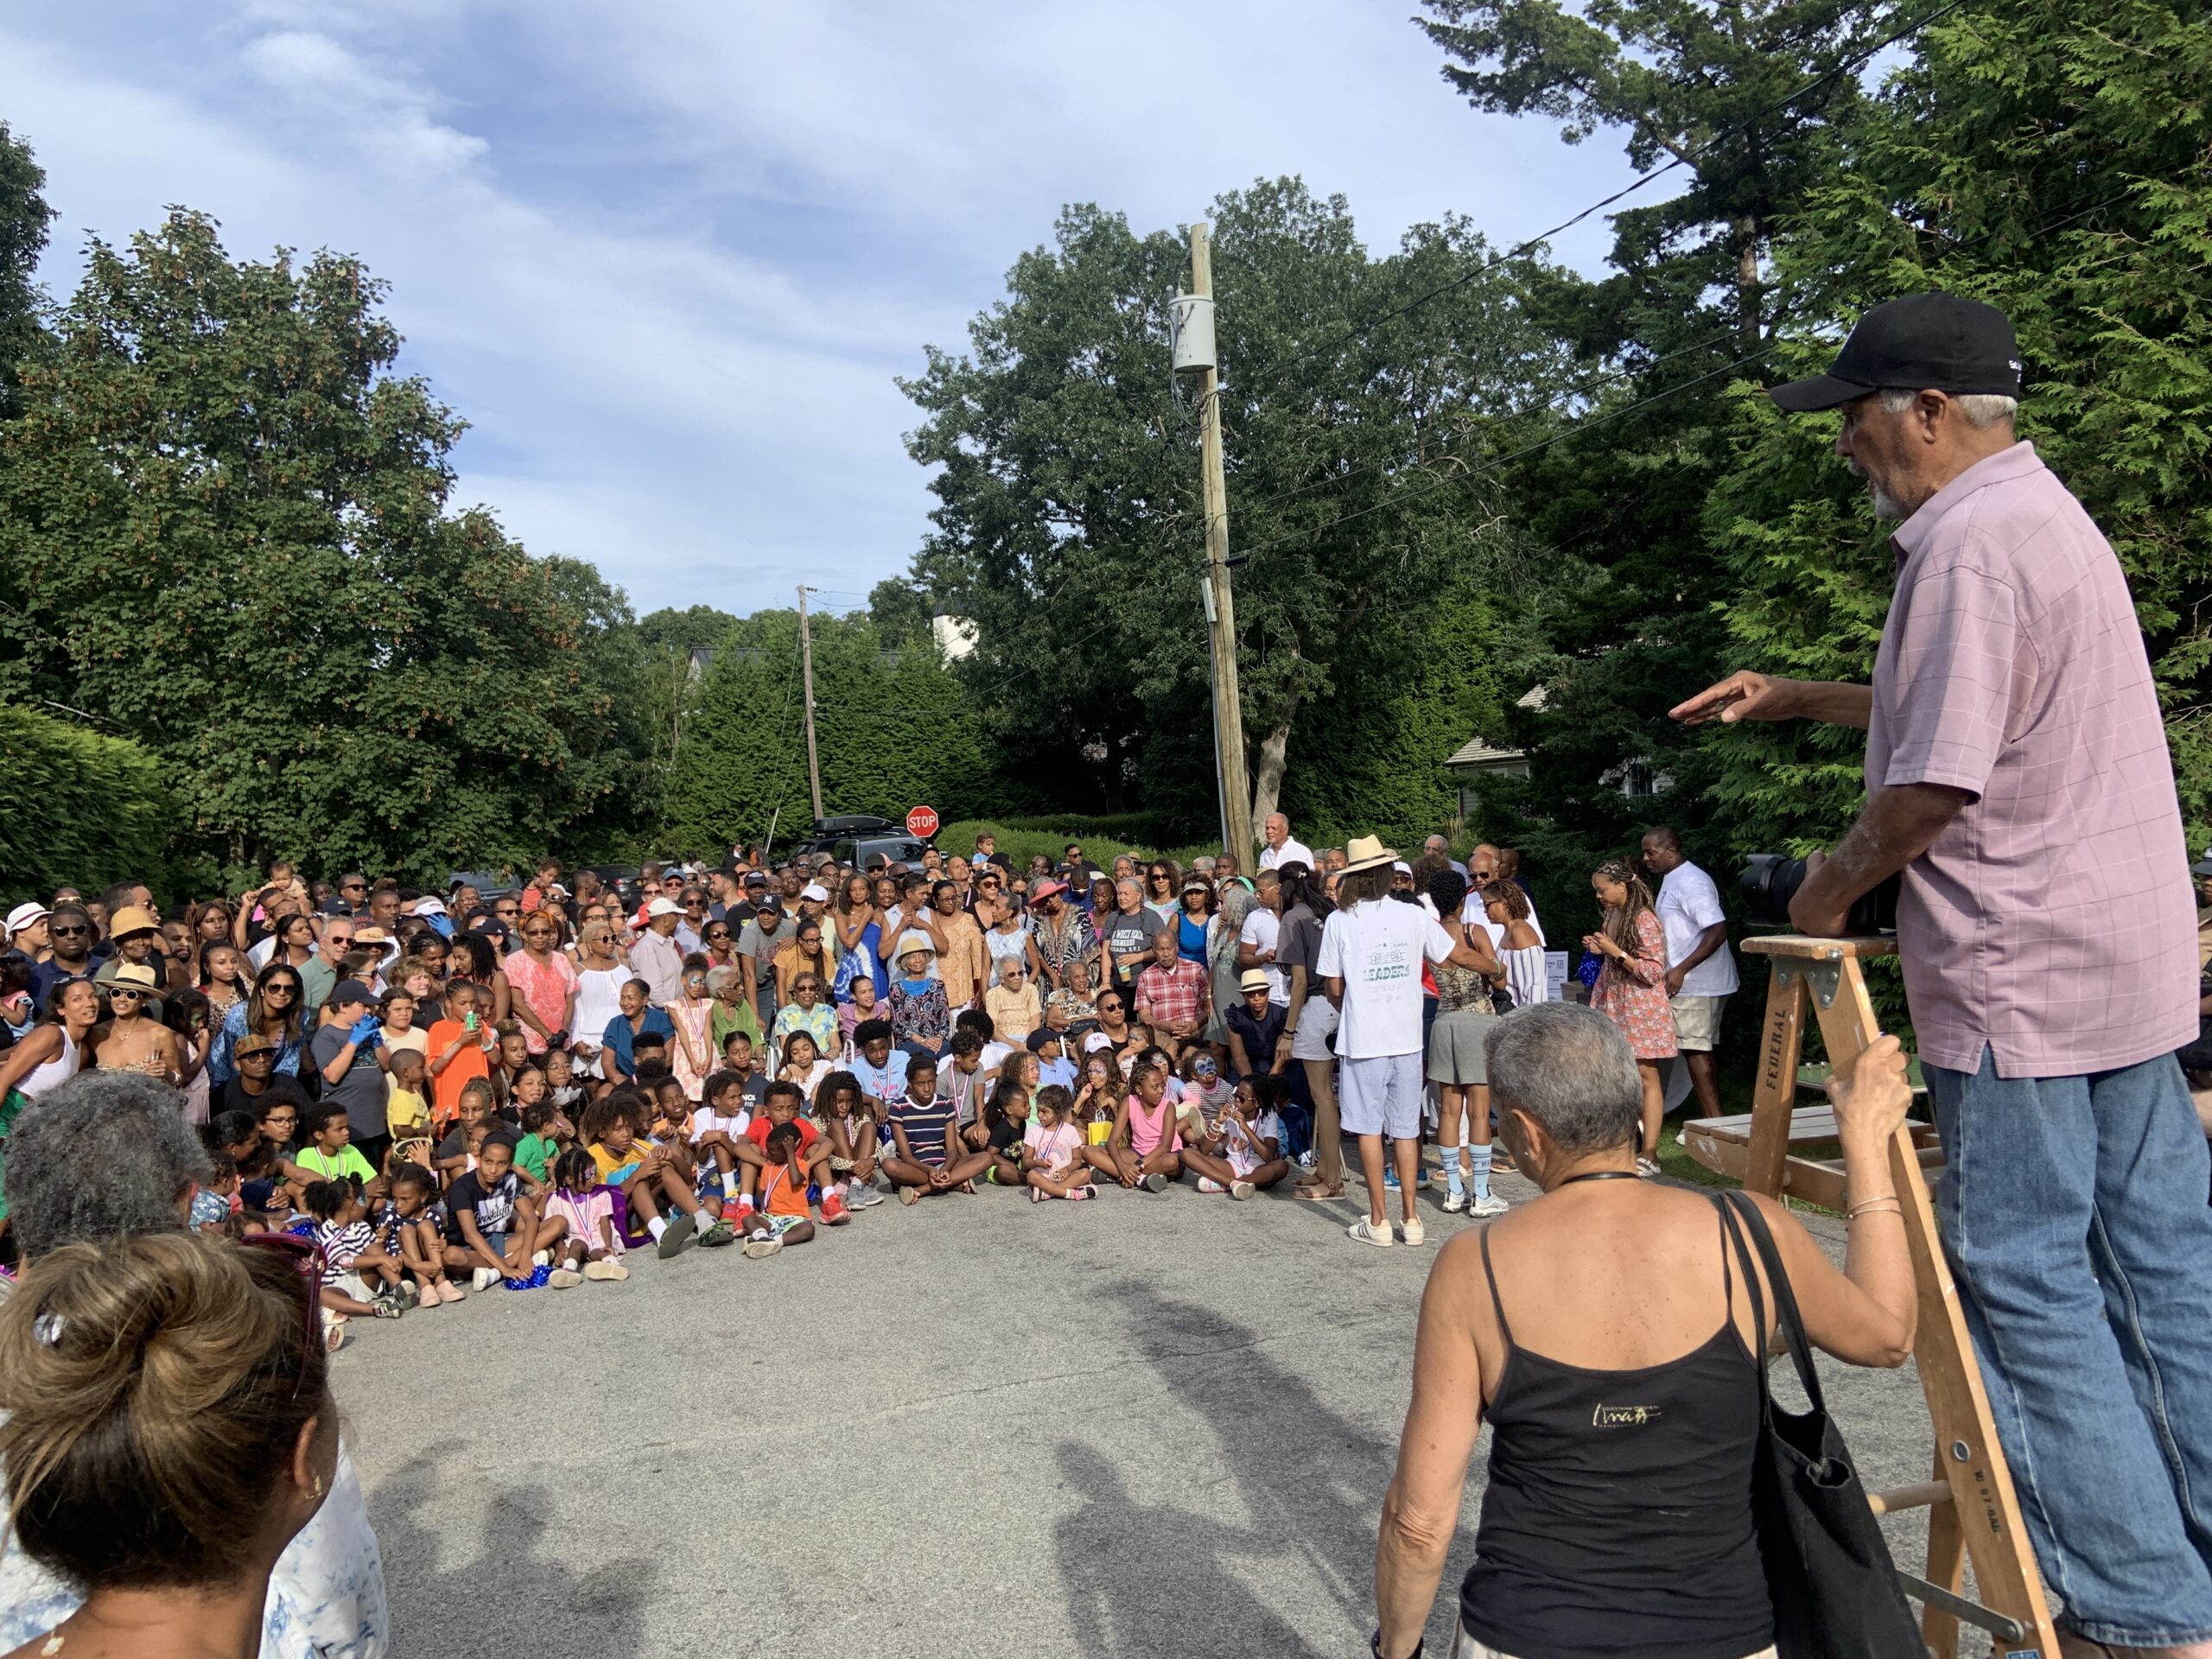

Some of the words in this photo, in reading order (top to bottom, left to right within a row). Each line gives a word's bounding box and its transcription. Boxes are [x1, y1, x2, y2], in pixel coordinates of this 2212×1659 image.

[909, 816, 936, 829] STOP
[1363, 964, 1410, 982] LEADERS
[1765, 1009, 1786, 1090] FEDERAL
[474, 1204, 511, 1224] Brooklyn
